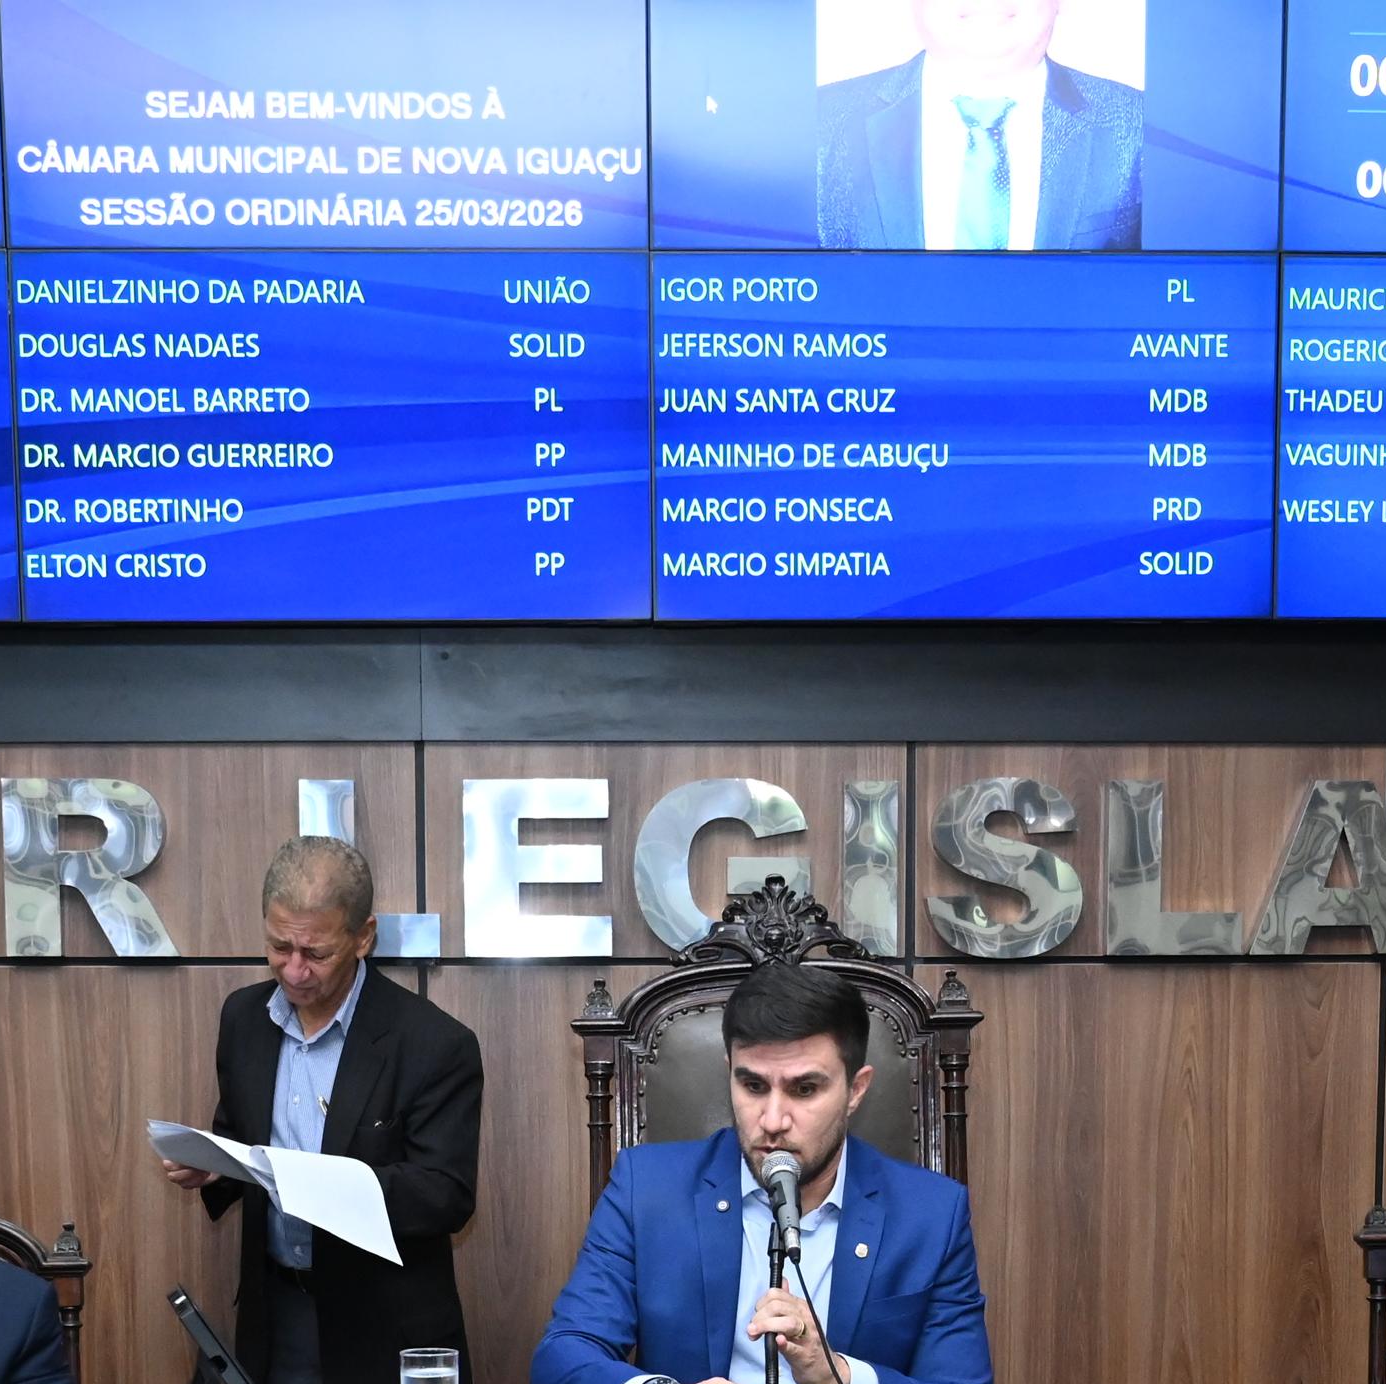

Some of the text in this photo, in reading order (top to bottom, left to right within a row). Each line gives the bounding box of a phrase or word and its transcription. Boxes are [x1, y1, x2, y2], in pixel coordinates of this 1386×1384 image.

[144, 85, 506, 121] SEJAM BEM-VINDOS À
[16, 137, 643, 183] CÂMARA MUNICIPAL DE NOVA IGUAÇU
[78, 190, 584, 228] SESSÃO ORDINÁRIA 25/03/2026
[15, 278, 366, 305] DANIELZINHO DA PADARIA
[503, 274, 592, 305] UNIÃO
[659, 276, 819, 303] IGOR PORTO
[1166, 277, 1196, 304] PL
[17, 332, 261, 359] DOUGLAS NADAES
[508, 332, 586, 359] SOLID
[657, 332, 888, 359] JEFERSON RAMOS
[1128, 332, 1230, 359] AVANTE
[19, 386, 311, 414] DR. MANOEL BARRETO
[533, 386, 565, 413] PL
[658, 386, 897, 414] JUAN SANTA CRUZ
[1148, 387, 1209, 414] MDB
[1283, 387, 1384, 414] THADEU
[22, 442, 335, 469] DR. MARCIO GUERREIRO
[534, 441, 567, 468] PP
[661, 442, 950, 474] MANINHO DE CABUÇU
[1147, 442, 1208, 468] MDB
[24, 497, 245, 524] DR. ROBERTINHO
[525, 496, 576, 523] PDT
[661, 496, 895, 524] MARCIO FONSECA
[1151, 496, 1203, 522] PRD
[1281, 498, 1376, 524] WESLEY
[25, 552, 208, 579] ELTON CRISTO
[534, 551, 566, 578] PP
[662, 551, 892, 578] MARCIO SIMPATIA
[1138, 550, 1215, 576] SOLID
